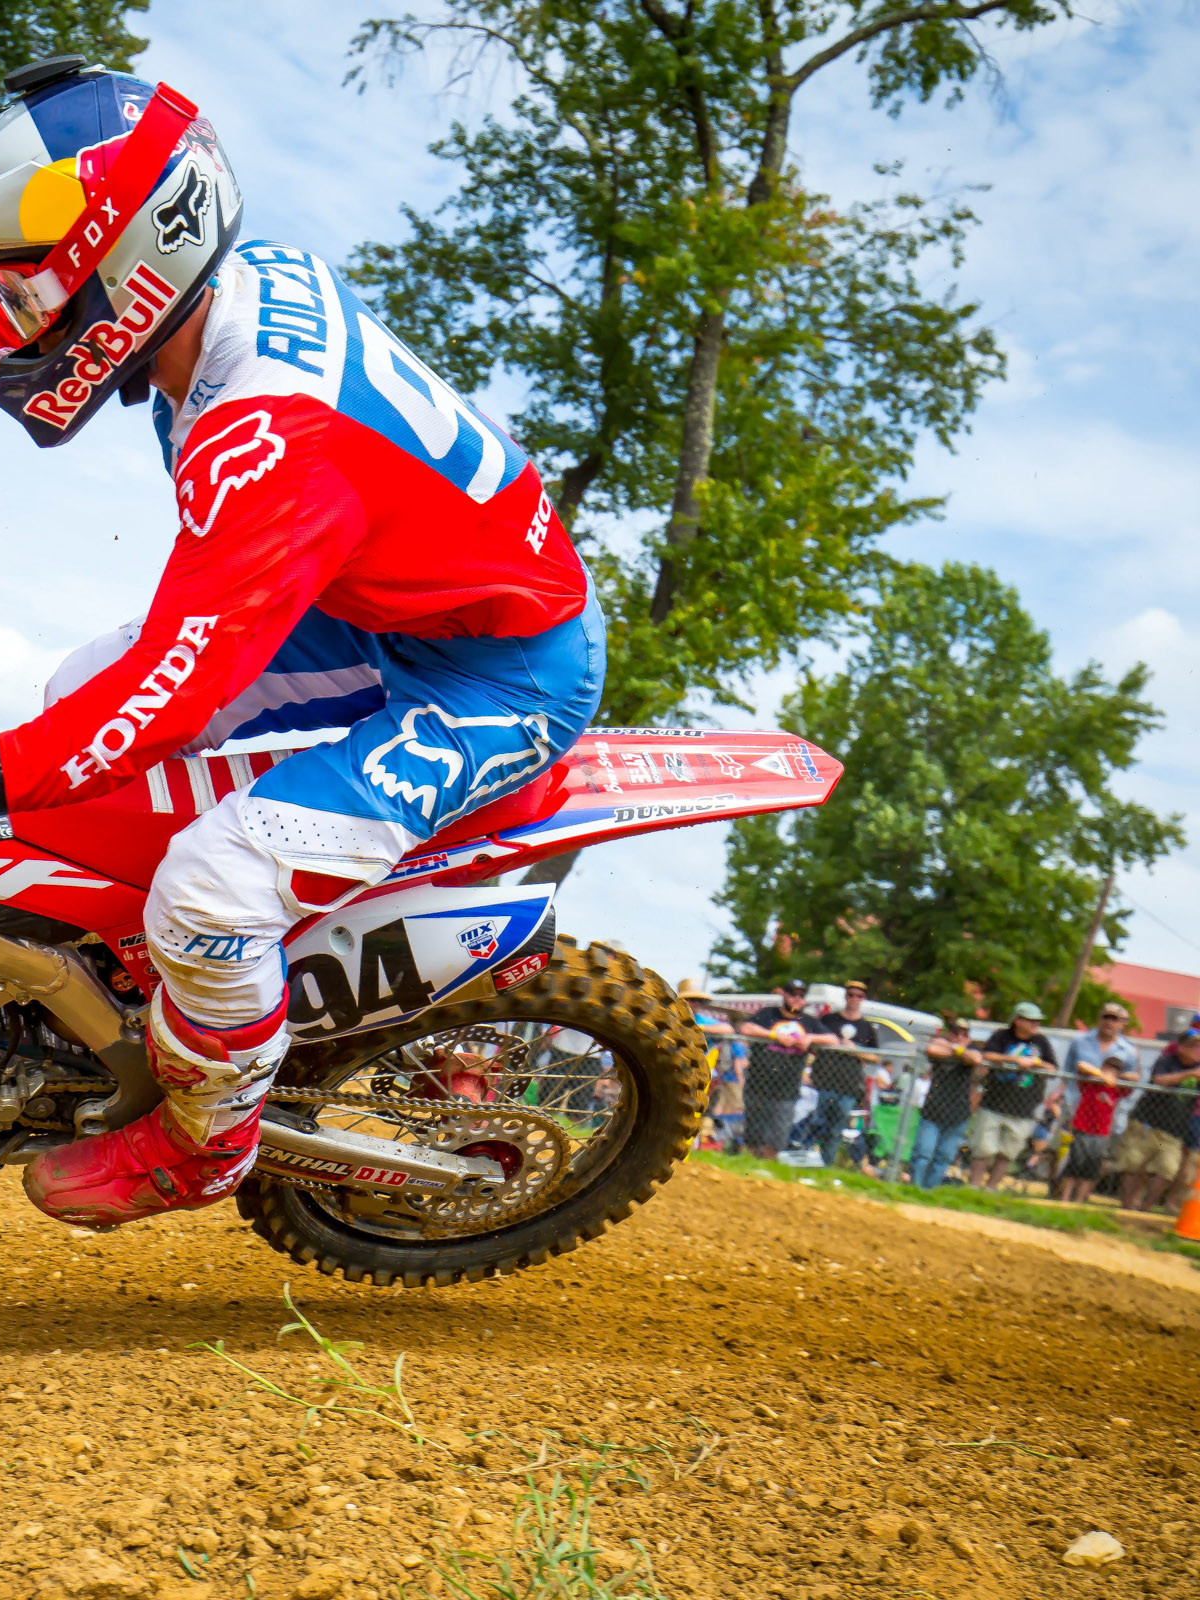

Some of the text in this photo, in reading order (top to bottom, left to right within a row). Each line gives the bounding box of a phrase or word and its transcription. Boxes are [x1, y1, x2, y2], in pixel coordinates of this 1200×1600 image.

[67, 197, 120, 268] FOX
[234, 240, 328, 378] ROCZE
[60, 614, 220, 790] HONDA
[614, 794, 735, 823] DUNLOP
[184, 934, 256, 961] FOX
[502, 956, 542, 985] ヨシムラ
[287, 918, 437, 1039] 94
[258, 1144, 349, 1175] ENTHAL
